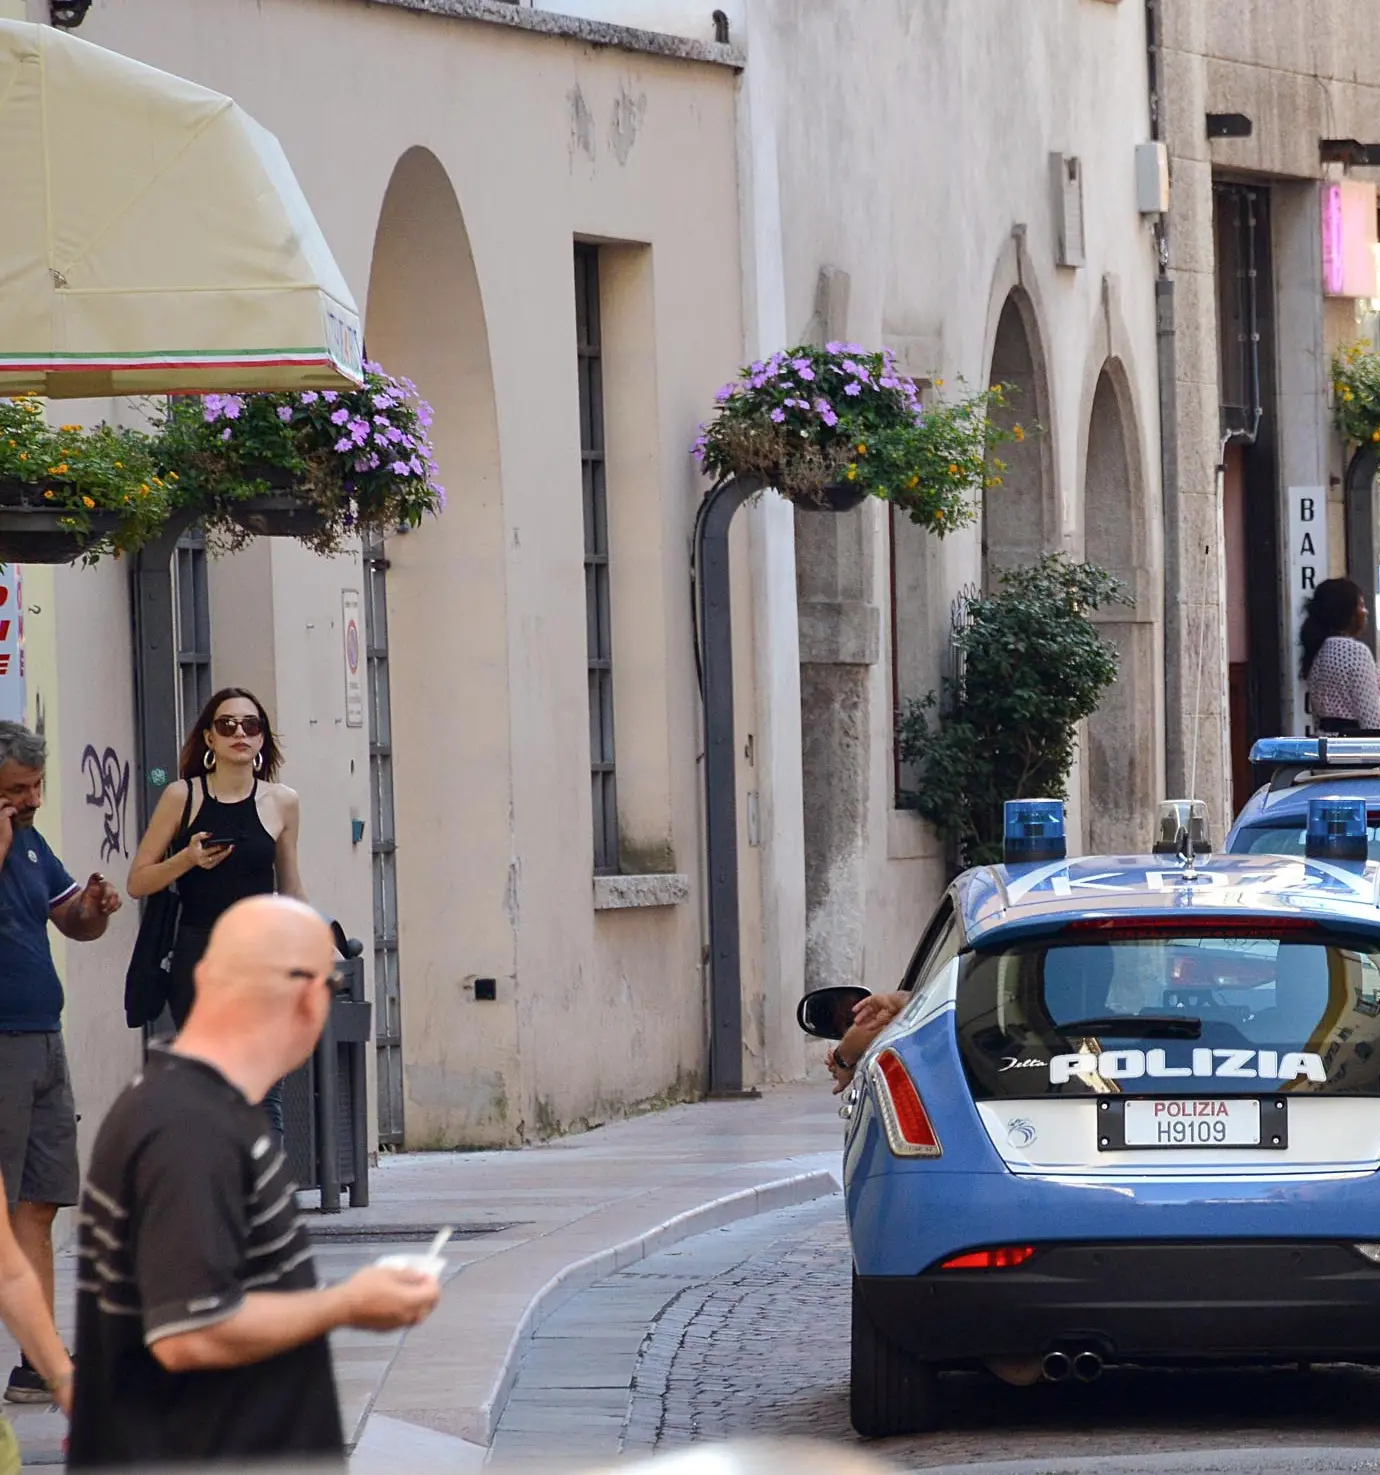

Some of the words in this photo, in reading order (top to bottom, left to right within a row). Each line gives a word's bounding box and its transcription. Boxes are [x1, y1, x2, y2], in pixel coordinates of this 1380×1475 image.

[1300, 498, 1316, 590] BAR
[998, 1056, 1048, 1072] Delta
[1049, 1047, 1327, 1084] POLIZIA
[1154, 1101, 1230, 1117] POLIZIA
[1157, 1121, 1227, 1144] H9109
